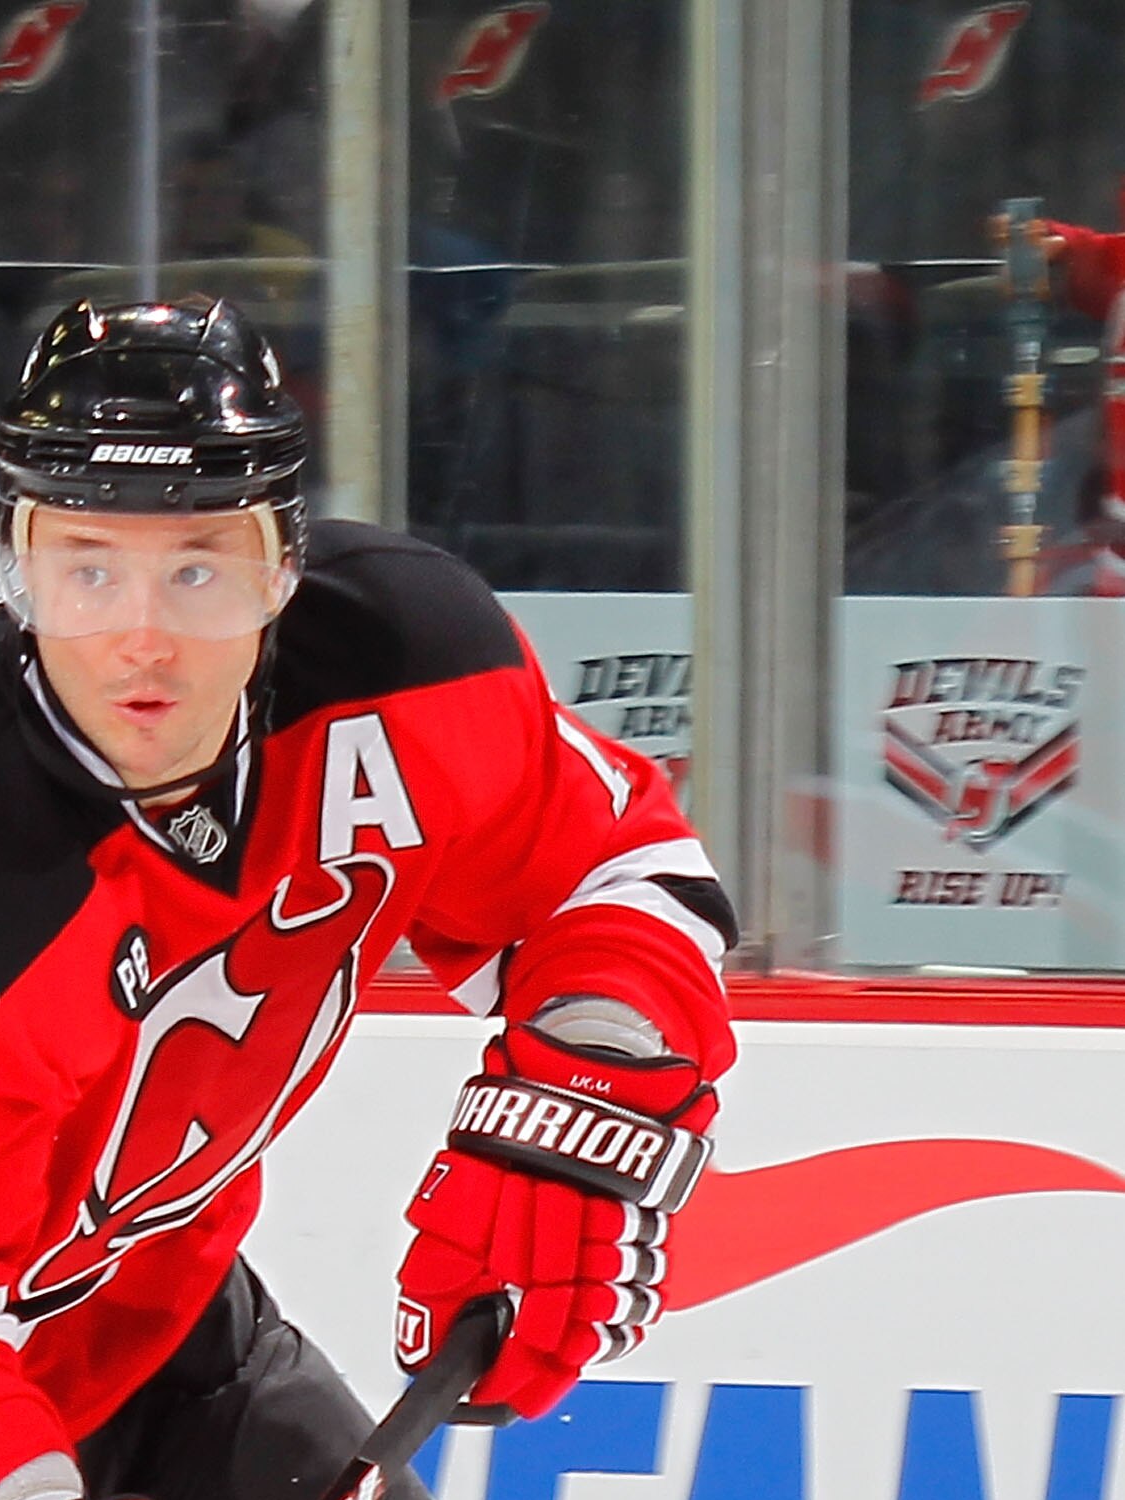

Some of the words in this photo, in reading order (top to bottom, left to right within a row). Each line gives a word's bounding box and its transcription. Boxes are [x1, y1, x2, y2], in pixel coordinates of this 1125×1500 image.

[887, 656, 1087, 708] DEVILS
[933, 710, 1051, 742] ARMY
[320, 712, 423, 863] A
[893, 871, 986, 905] RISE
